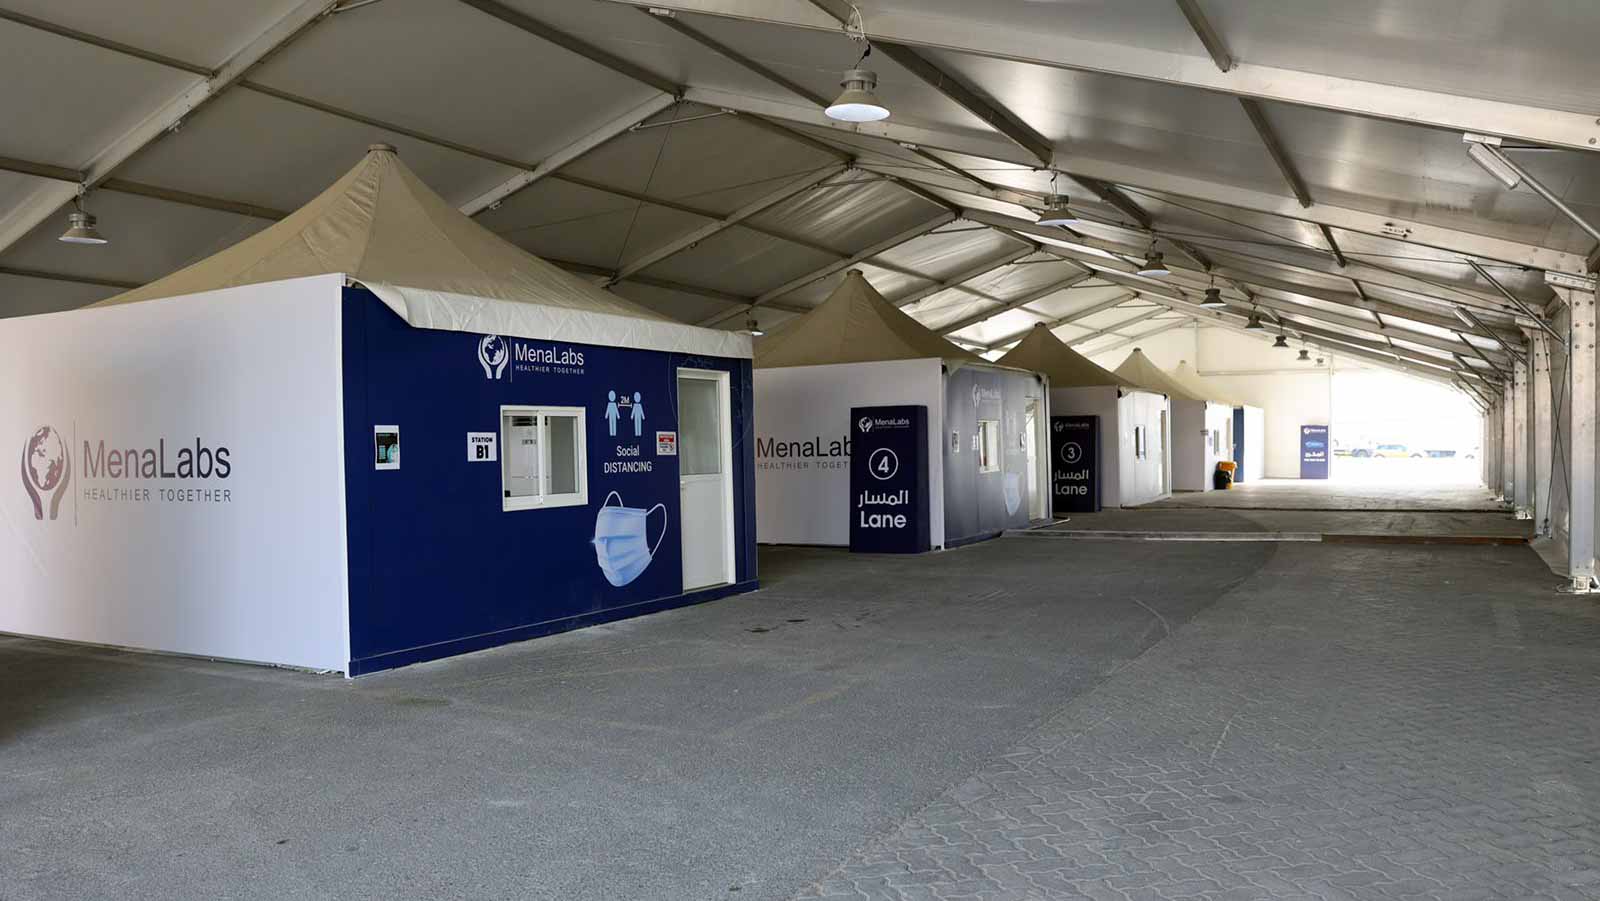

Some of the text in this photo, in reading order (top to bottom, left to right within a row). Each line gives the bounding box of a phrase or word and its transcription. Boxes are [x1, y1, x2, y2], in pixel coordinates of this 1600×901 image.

[515, 343, 584, 366] MenaLabs
[515, 364, 584, 375] HEALTHIER TOGETHER
[620, 395, 630, 404] 2M
[875, 418, 910, 426] MenaLabs
[476, 444, 489, 459] B1
[616, 445, 640, 457] Social
[1067, 447, 1076, 459] 3
[83, 437, 232, 479] MenaLabs
[878, 455, 890, 473] 4
[603, 461, 653, 474] DISTANCING
[1053, 469, 1089, 482] المسار
[83, 488, 232, 502] HEALTHIER TOGETHER
[1055, 483, 1088, 495] Lane
[858, 489, 909, 508] المسار
[860, 510, 907, 528] Lane
